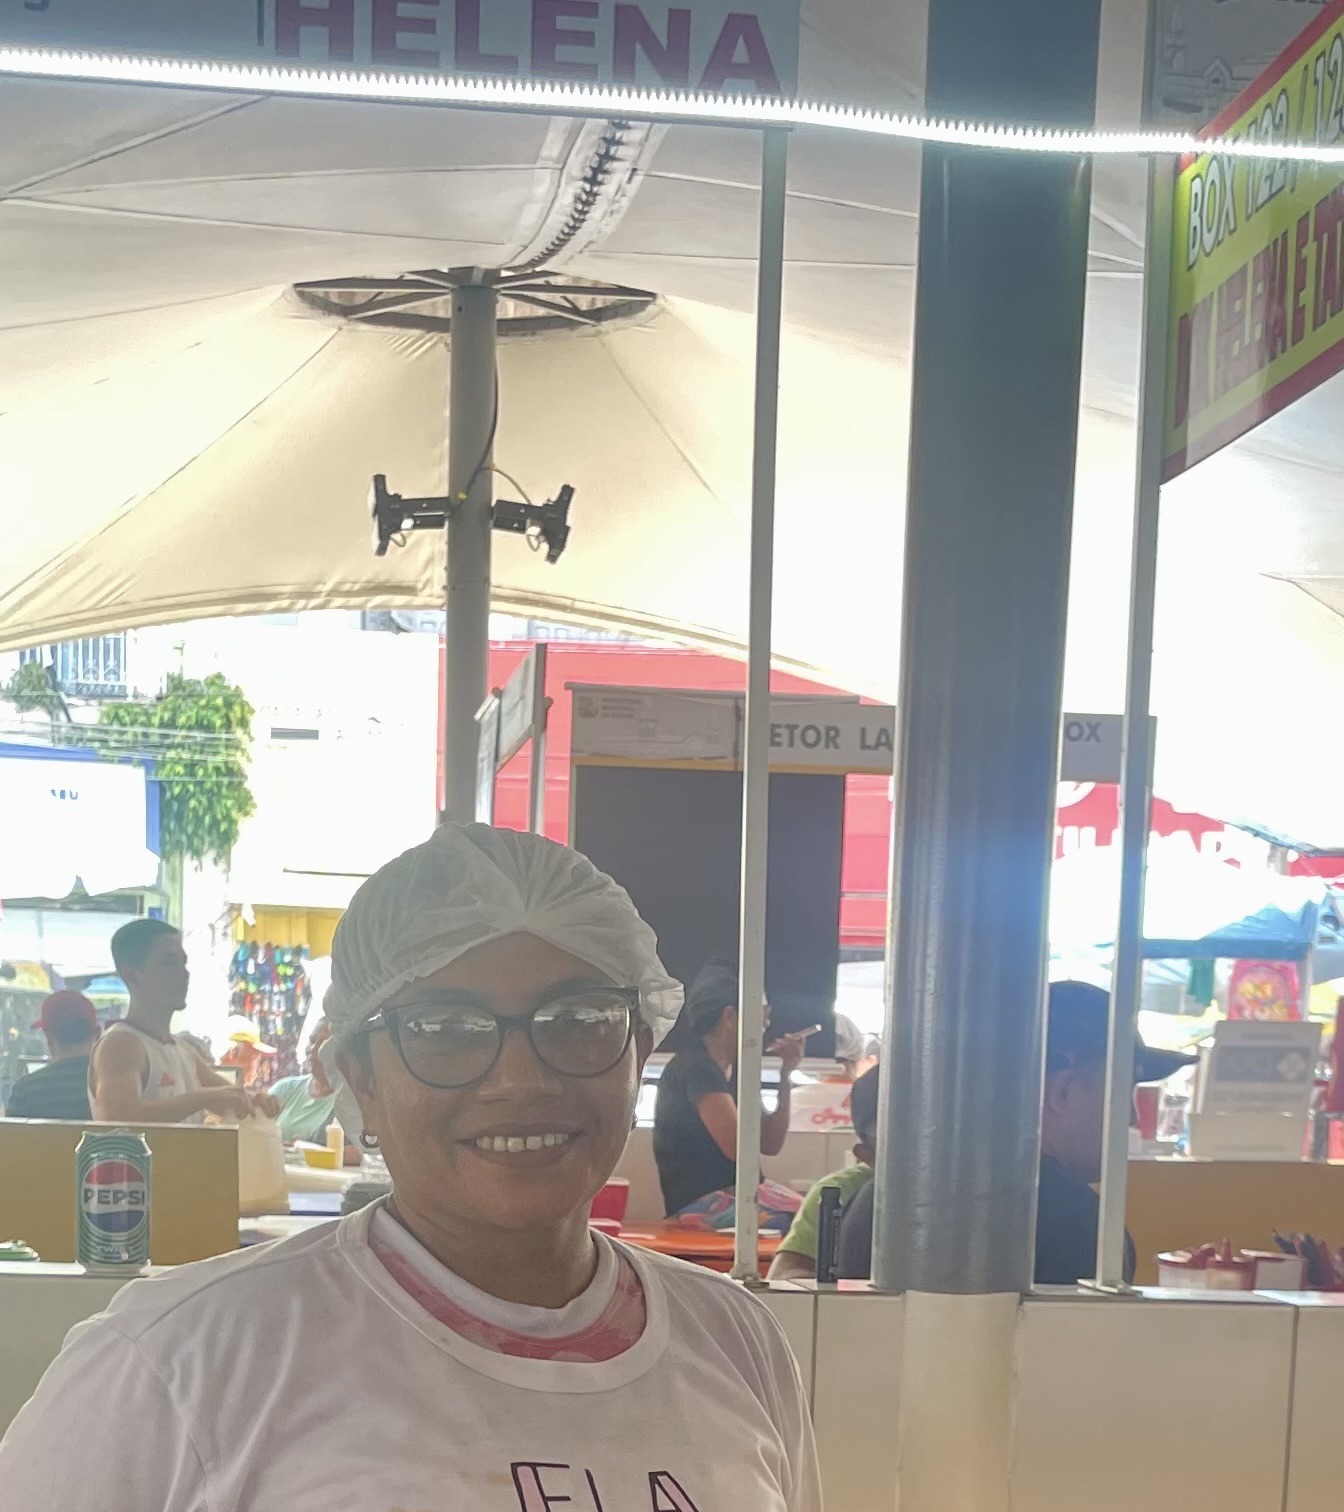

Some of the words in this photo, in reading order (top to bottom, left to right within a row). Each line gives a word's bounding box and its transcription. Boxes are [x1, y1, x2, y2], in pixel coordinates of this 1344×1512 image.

[275, 0, 781, 93] HELENA
[1188, 140, 1237, 272] BOX
[769, 722, 841, 751] ETOR
[1065, 720, 1102, 743] OX
[83, 1188, 146, 1205] PEPSI
